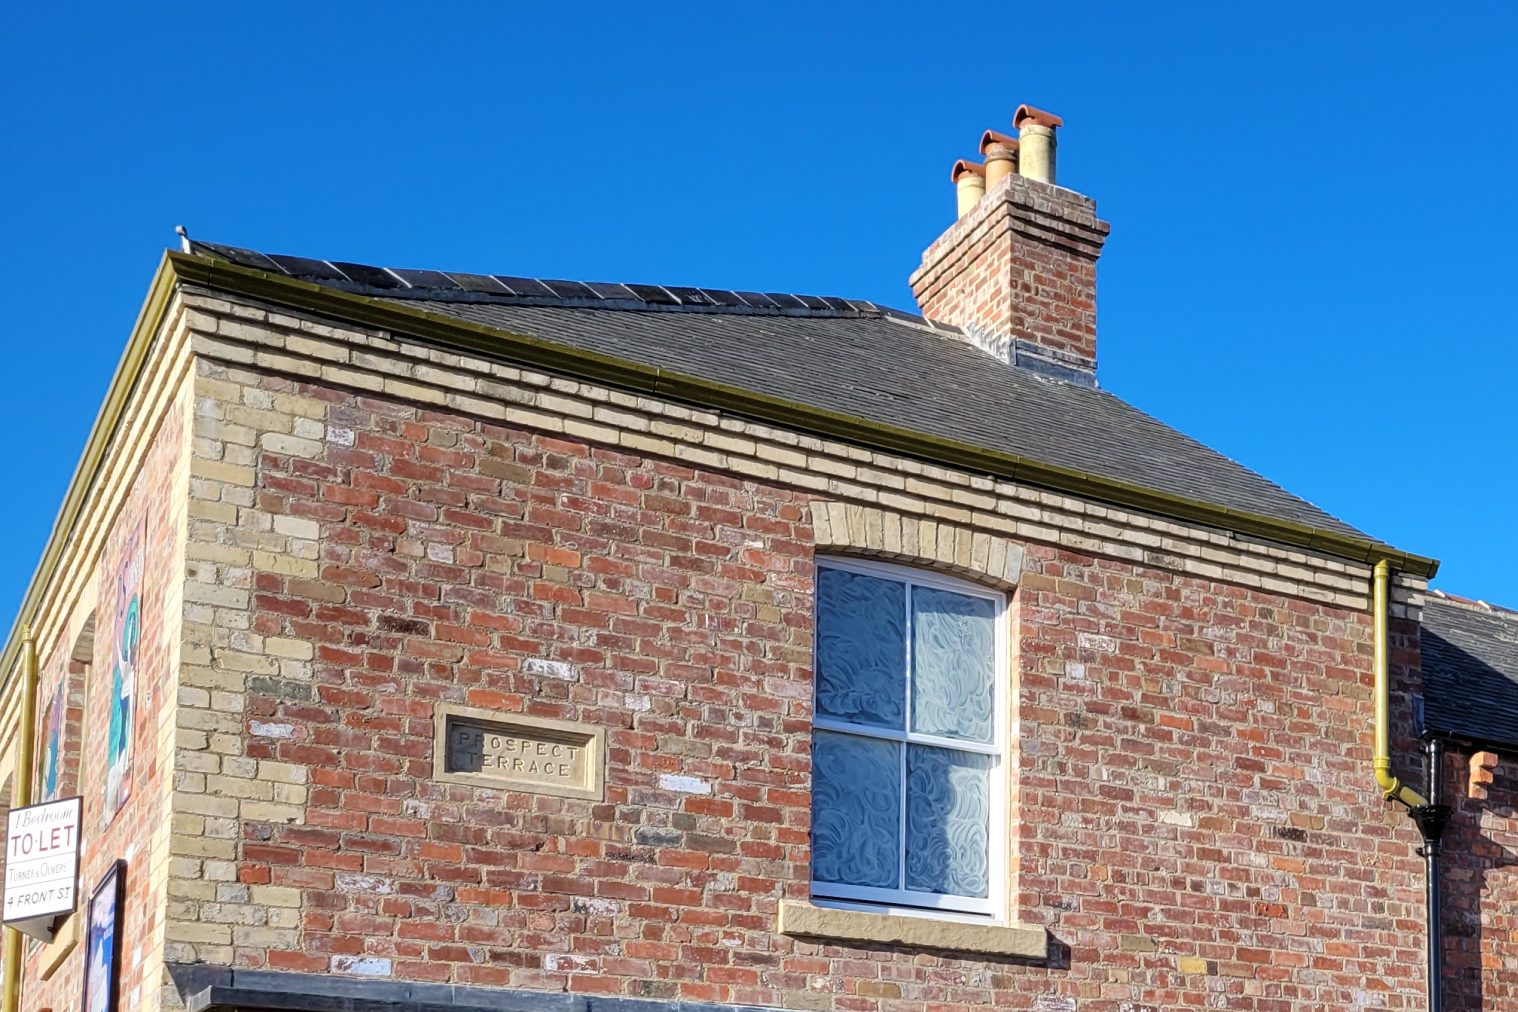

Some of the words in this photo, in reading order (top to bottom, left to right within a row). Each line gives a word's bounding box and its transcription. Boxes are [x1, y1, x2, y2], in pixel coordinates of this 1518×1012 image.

[459, 732, 578, 762] PROSPECT
[467, 751, 572, 778] TERRACE
[17, 889, 55, 906] FRONT
[57, 887, 71, 899] ST
